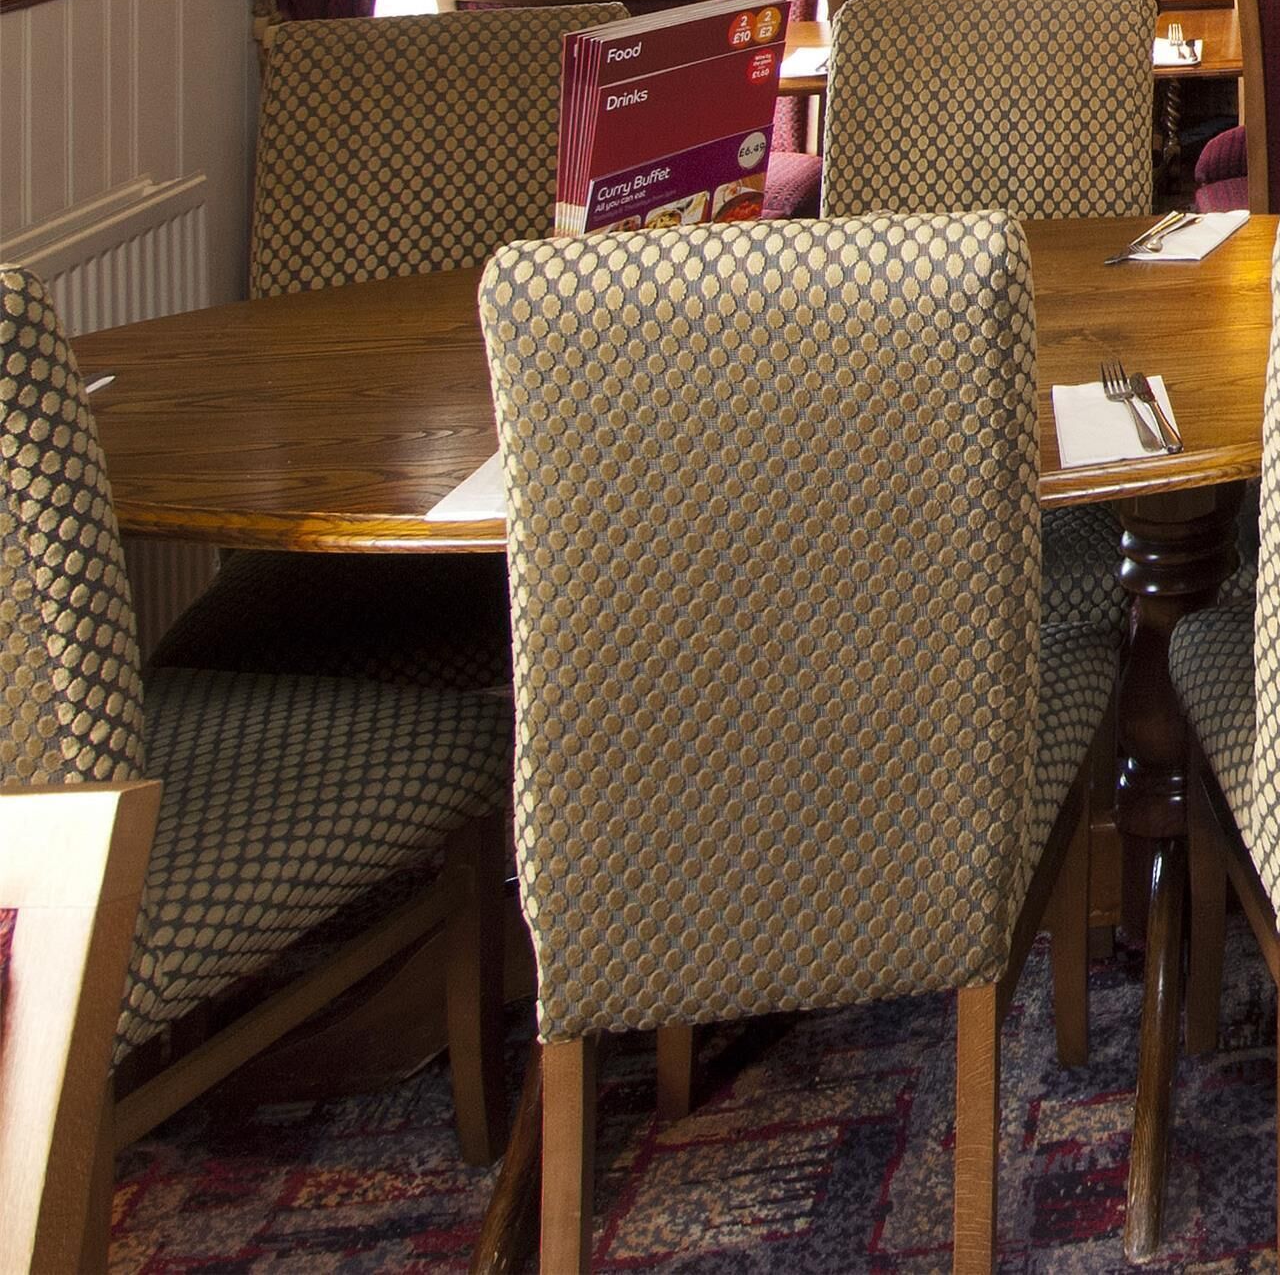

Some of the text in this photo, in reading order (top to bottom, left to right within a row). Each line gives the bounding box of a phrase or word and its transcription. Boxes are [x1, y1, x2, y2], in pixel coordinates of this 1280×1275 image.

[740, 15, 748, 27] 2
[764, 11, 772, 22] 2
[732, 30, 751, 44] £10
[759, 26, 773, 38] £2
[607, 41, 642, 63] Food
[606, 89, 648, 111] Drinks
[597, 167, 671, 201] Curry Buffet
[595, 189, 646, 213] All you can eat
